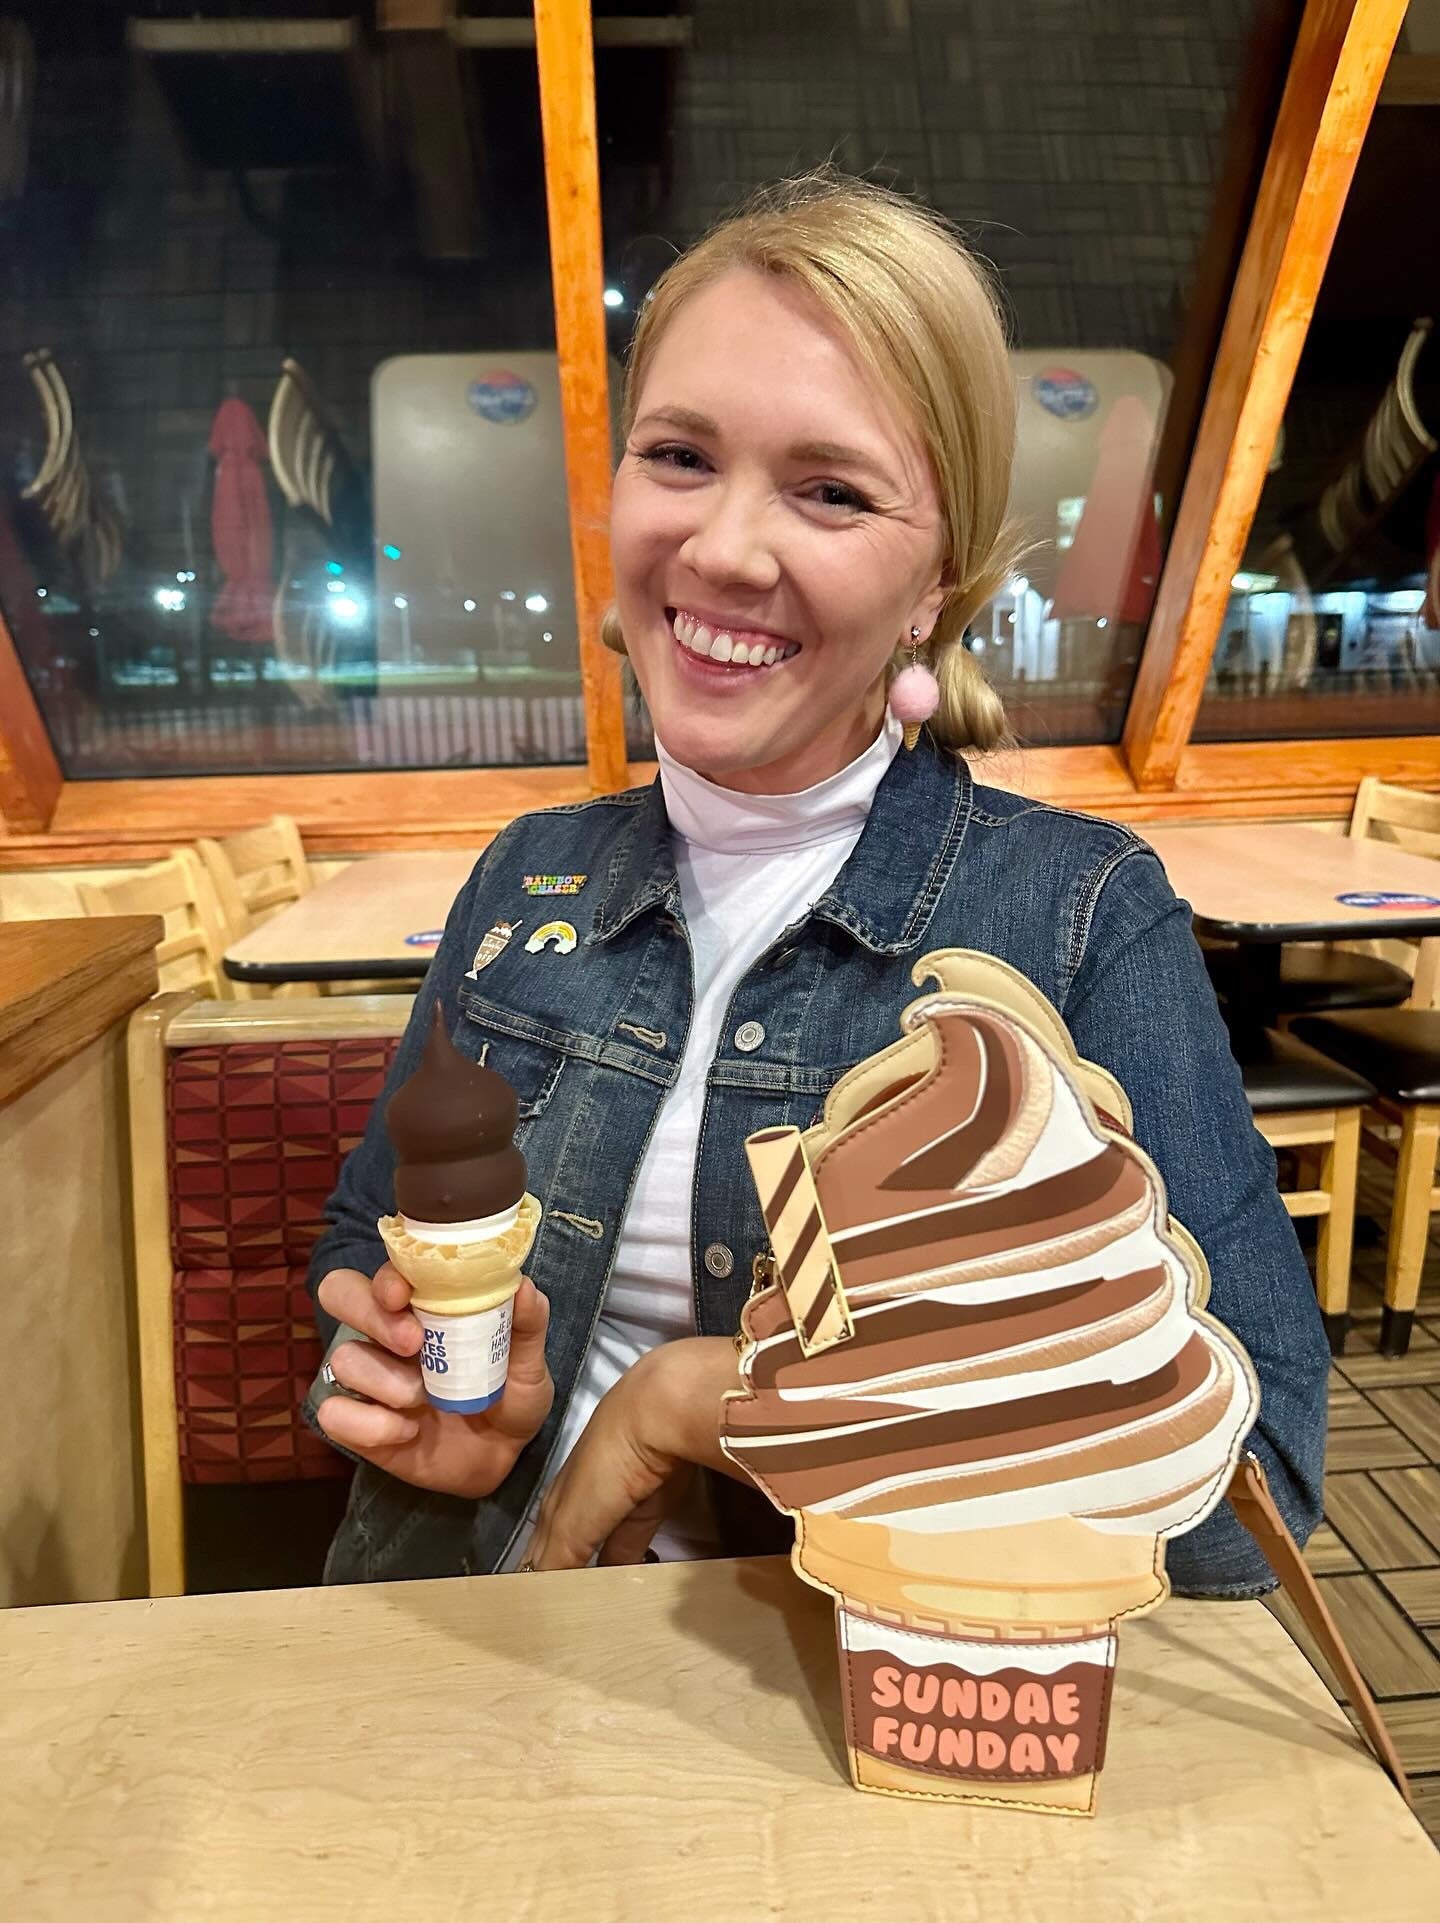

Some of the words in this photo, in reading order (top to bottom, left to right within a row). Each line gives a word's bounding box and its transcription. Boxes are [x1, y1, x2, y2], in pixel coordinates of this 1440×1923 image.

[525, 875, 587, 885] RAINBOW
[530, 884, 578, 894] CHASER
[424, 1328, 445, 1345] PY
[423, 1341, 447, 1358] TES
[871, 1666, 1080, 1725] SUNDAE
[872, 1716, 1080, 1773] FUNDAY
